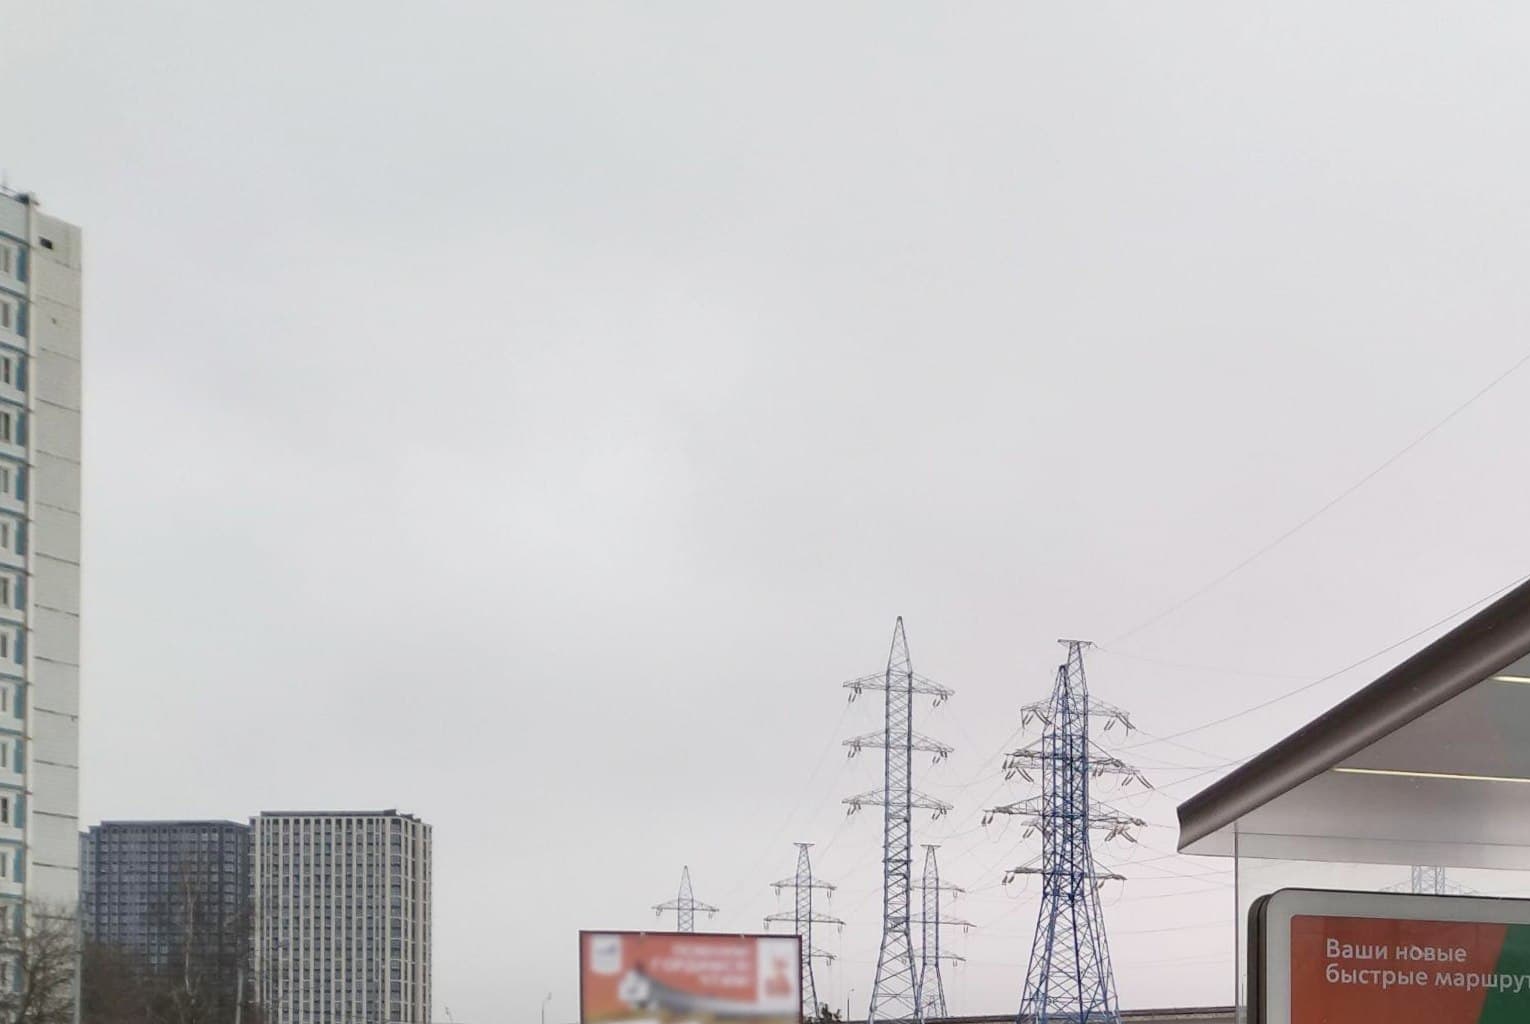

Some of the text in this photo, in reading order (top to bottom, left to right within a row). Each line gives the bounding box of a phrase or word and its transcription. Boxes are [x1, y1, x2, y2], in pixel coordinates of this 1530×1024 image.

[1326, 938, 1467, 962] Ваши новые
[1326, 963, 1429, 989] быстрые
